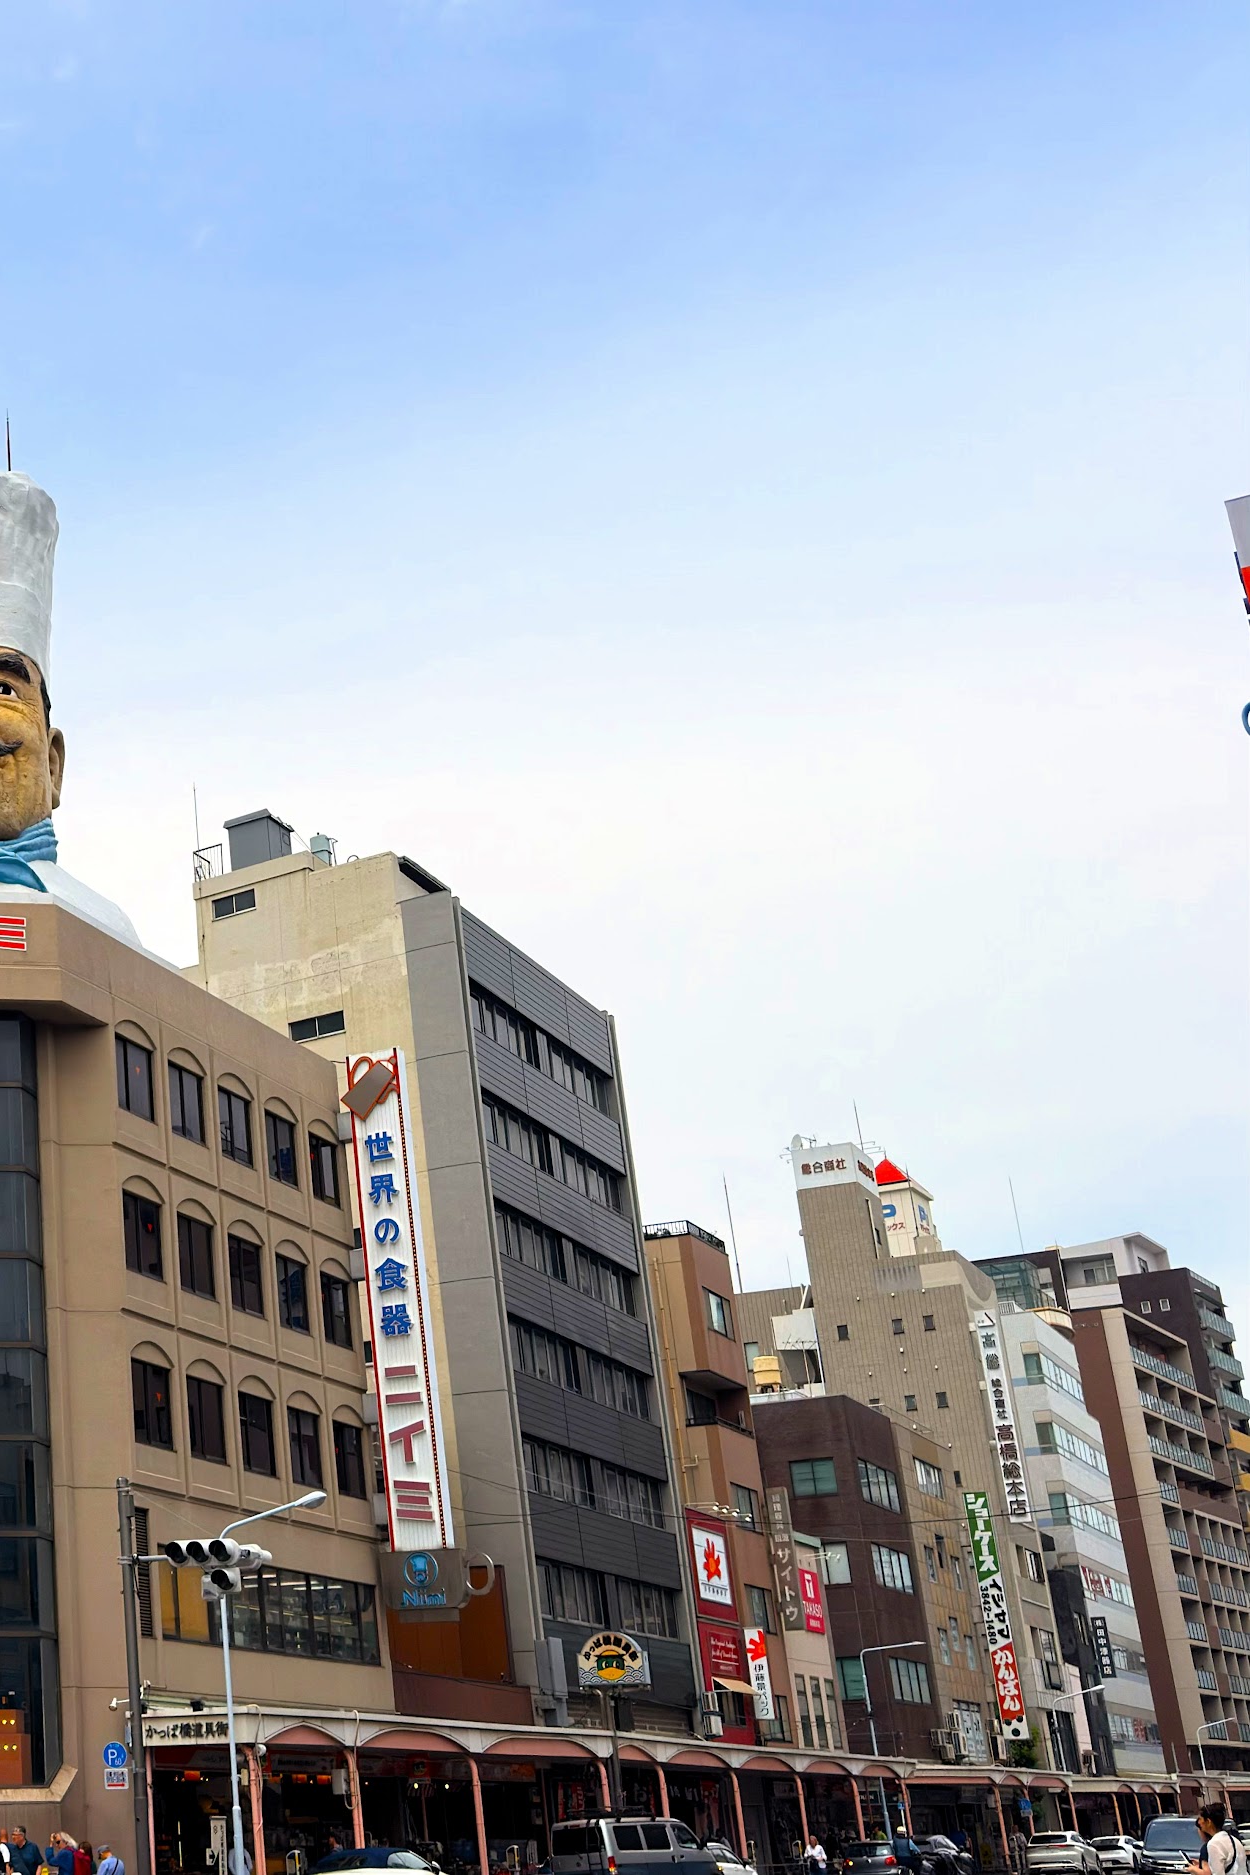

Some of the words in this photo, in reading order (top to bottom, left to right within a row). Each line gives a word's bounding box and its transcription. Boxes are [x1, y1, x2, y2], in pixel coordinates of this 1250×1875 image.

[365, 1131, 413, 1337] 世界の食器
[886, 1222, 905, 1232] ックス
[384, 1365, 434, 1521] ニイミ
[995, 1423, 1027, 1515] 高橋総本店
[966, 1493, 996, 1572] ショーケース
[401, 1587, 447, 1608] Niimi
[777, 1547, 798, 1621] サイトウ
[980, 1585, 998, 1645] 3842-1480
[993, 1649, 1021, 1712] かんばん
[108, 1749, 117, 1766] P
